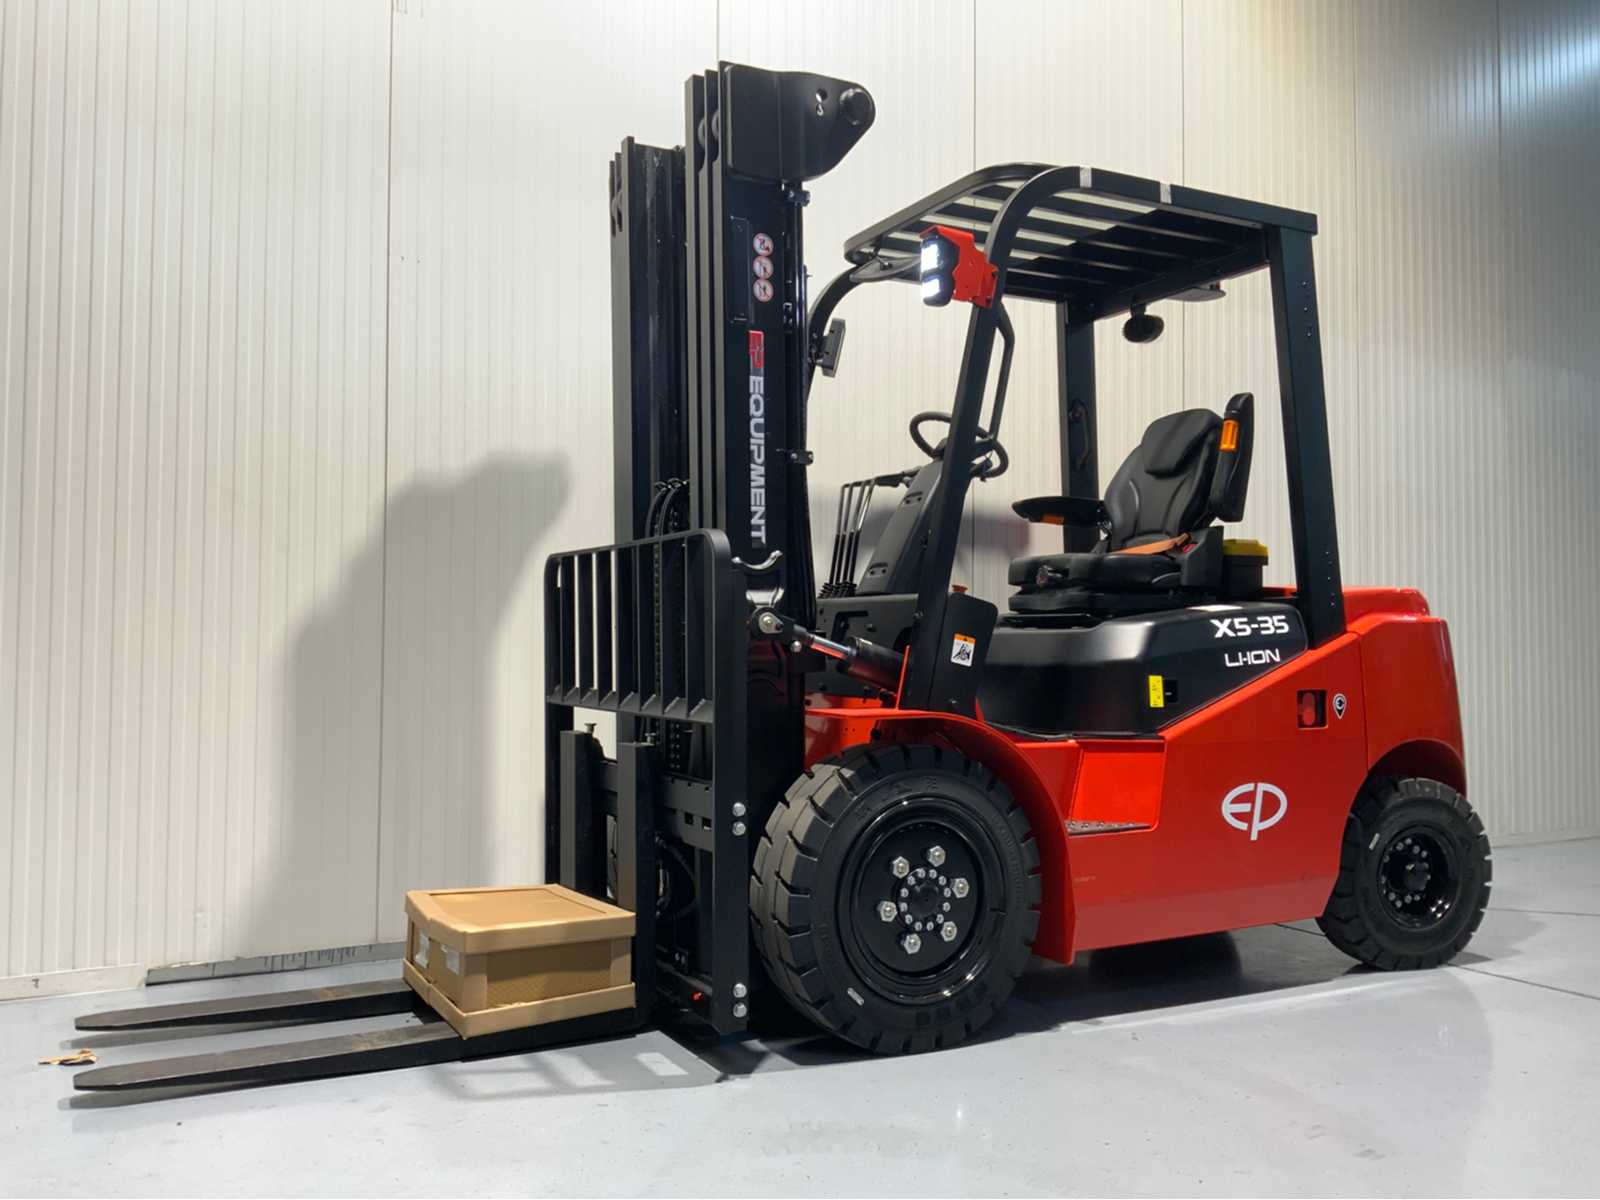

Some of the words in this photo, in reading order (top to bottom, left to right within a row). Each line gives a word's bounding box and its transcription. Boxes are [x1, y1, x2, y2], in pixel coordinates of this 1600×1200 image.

[749, 376, 766, 544] EQUIPMENT
[1209, 615, 1289, 638] X5-35
[1221, 782, 1288, 841] EP
